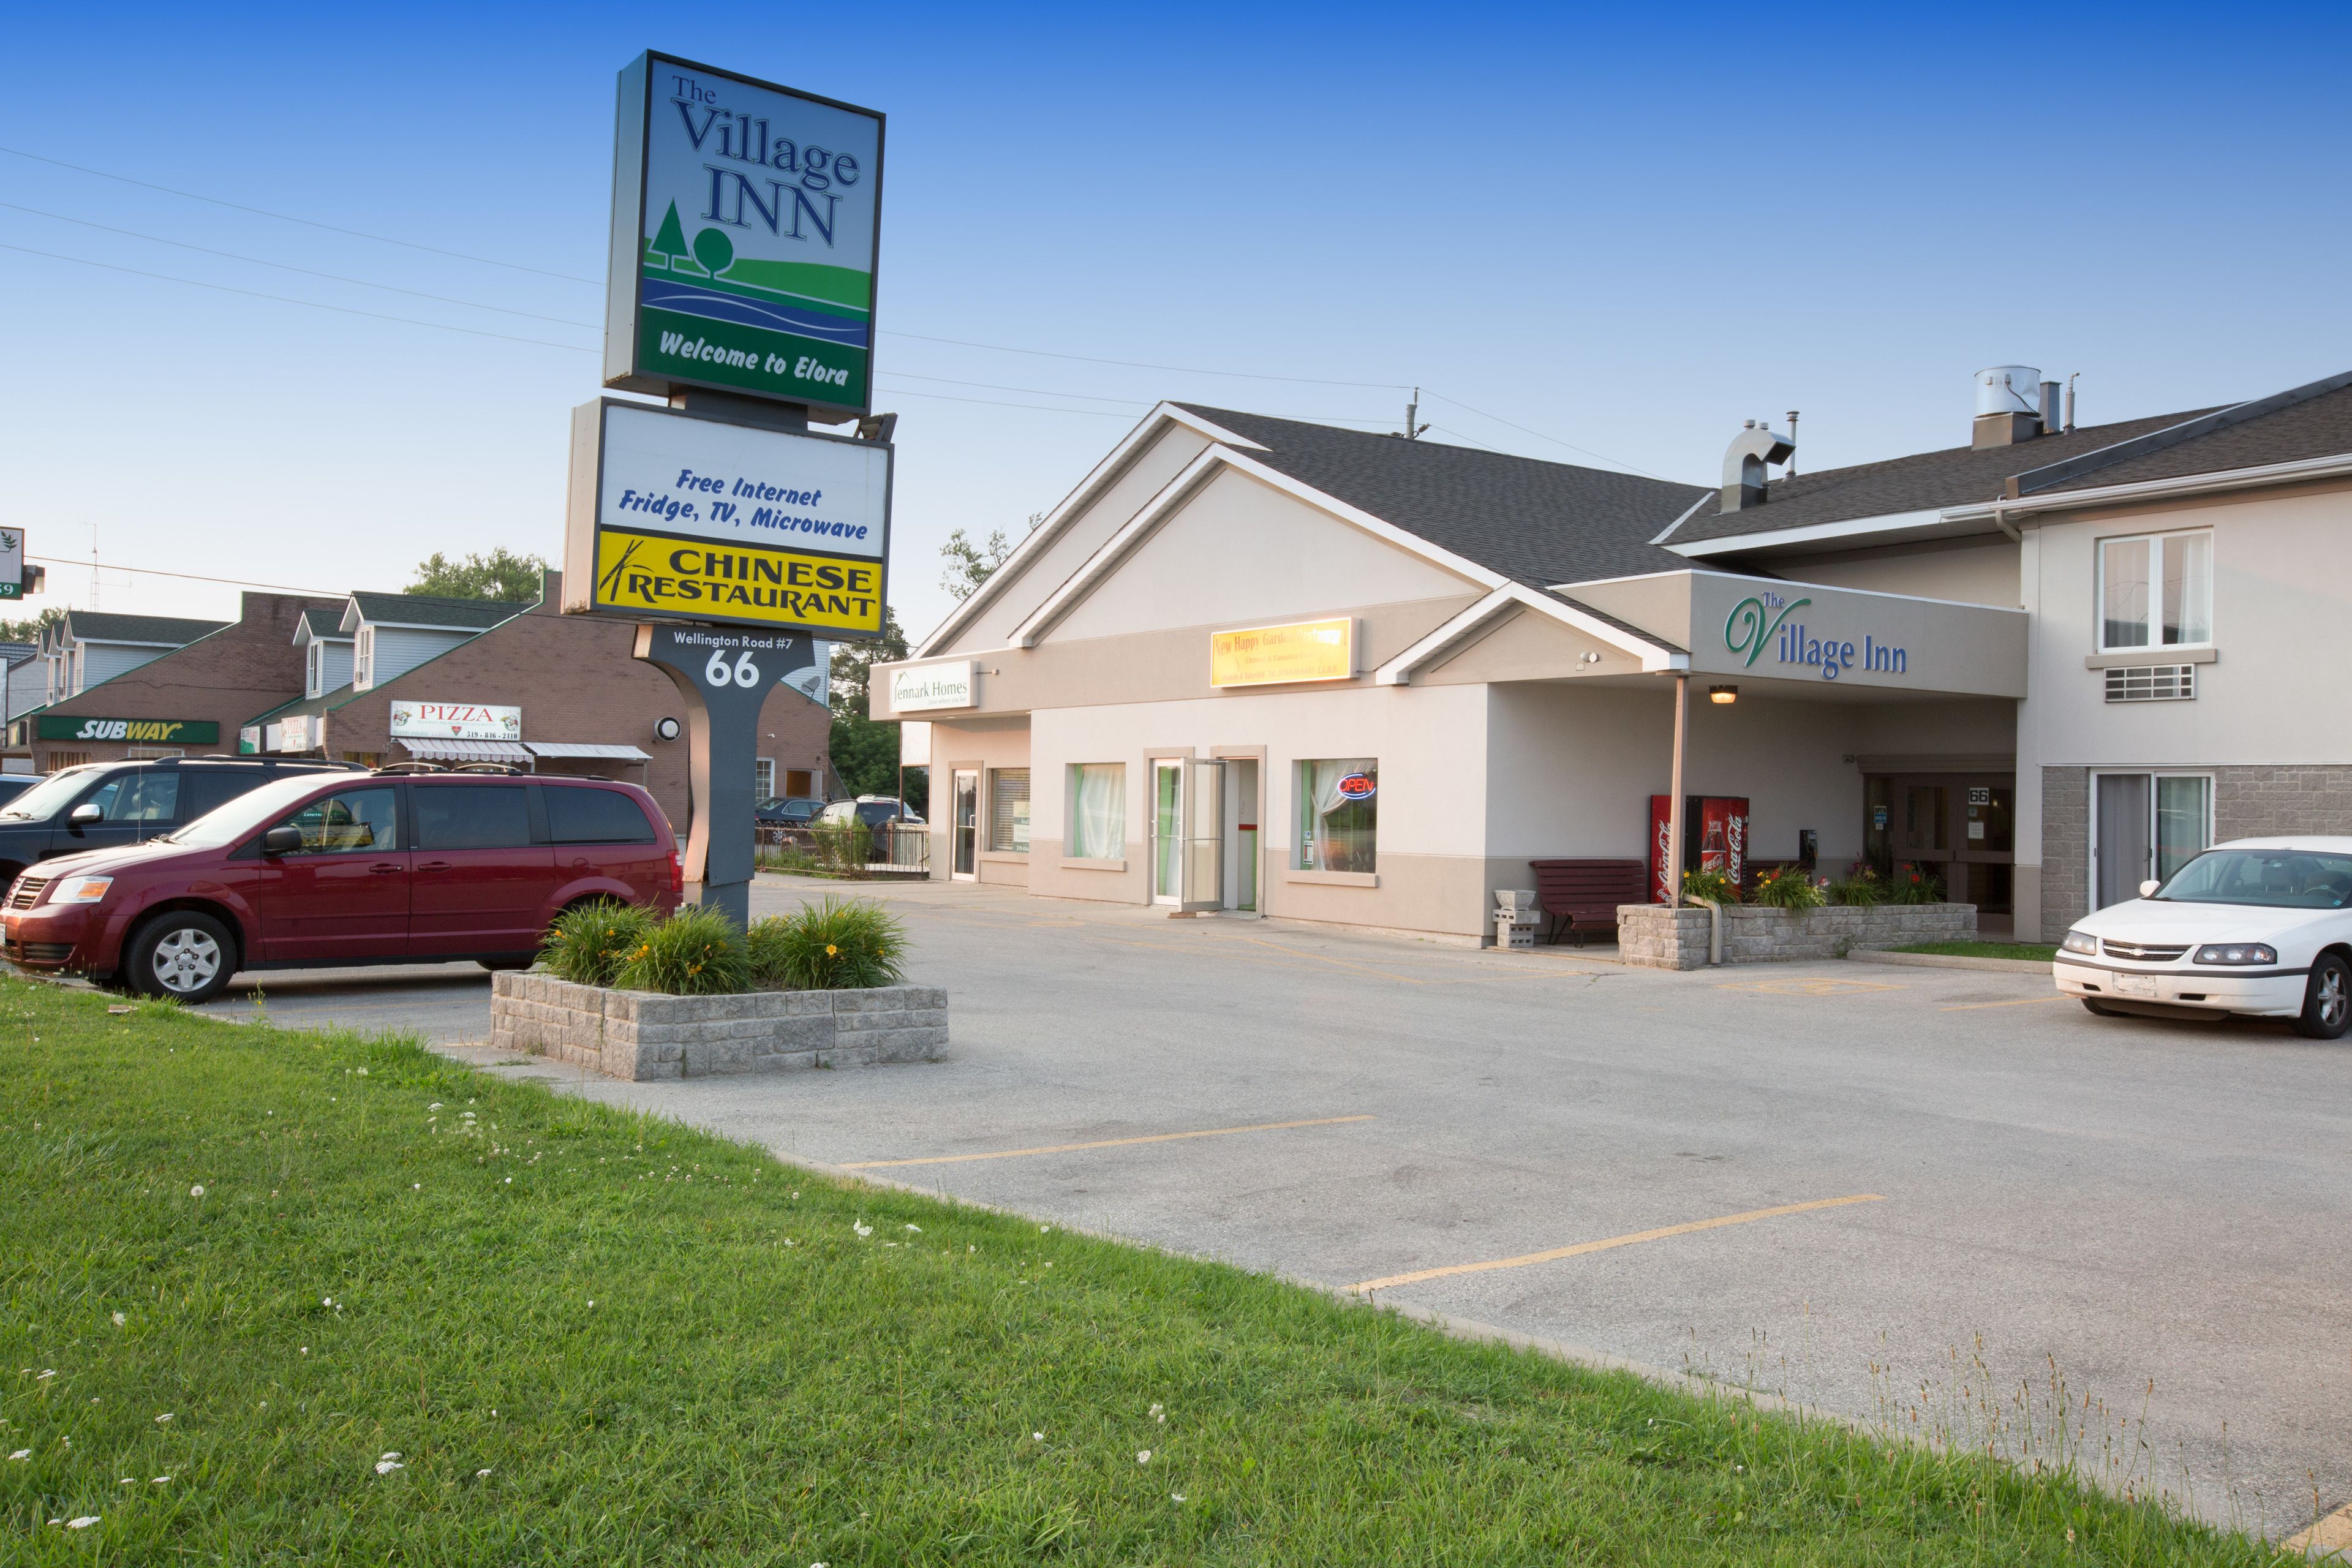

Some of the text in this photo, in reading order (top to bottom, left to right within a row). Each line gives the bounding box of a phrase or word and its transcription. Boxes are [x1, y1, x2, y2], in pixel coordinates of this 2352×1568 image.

[672, 75, 716, 104] The
[671, 97, 860, 191] Village
[701, 164, 843, 248] INN
[659, 330, 848, 386] Welcome to Elora
[676, 469, 821, 507] Free Internet
[618, 489, 868, 540] Fridge, TV, Microwave
[669, 549, 872, 594] CHINESE
[628, 573, 876, 618] RESTAURANT
[1762, 591, 1785, 609] The
[674, 631, 793, 649] Wellington Road #7
[1215, 638, 1232, 657] New
[1234, 635, 1260, 652] Happy
[1723, 597, 1907, 680] Village Inn
[705, 649, 760, 688] 66
[893, 681, 967, 704] Jennark Homes
[76, 720, 183, 740] SUBWAY
[288, 720, 303, 734] PIZZA
[420, 704, 494, 723] PIZZA
[1339, 778, 1374, 792] OPEN
[1970, 790, 1988, 802] 66
[1727, 812, 1742, 884] Coca-Cola
